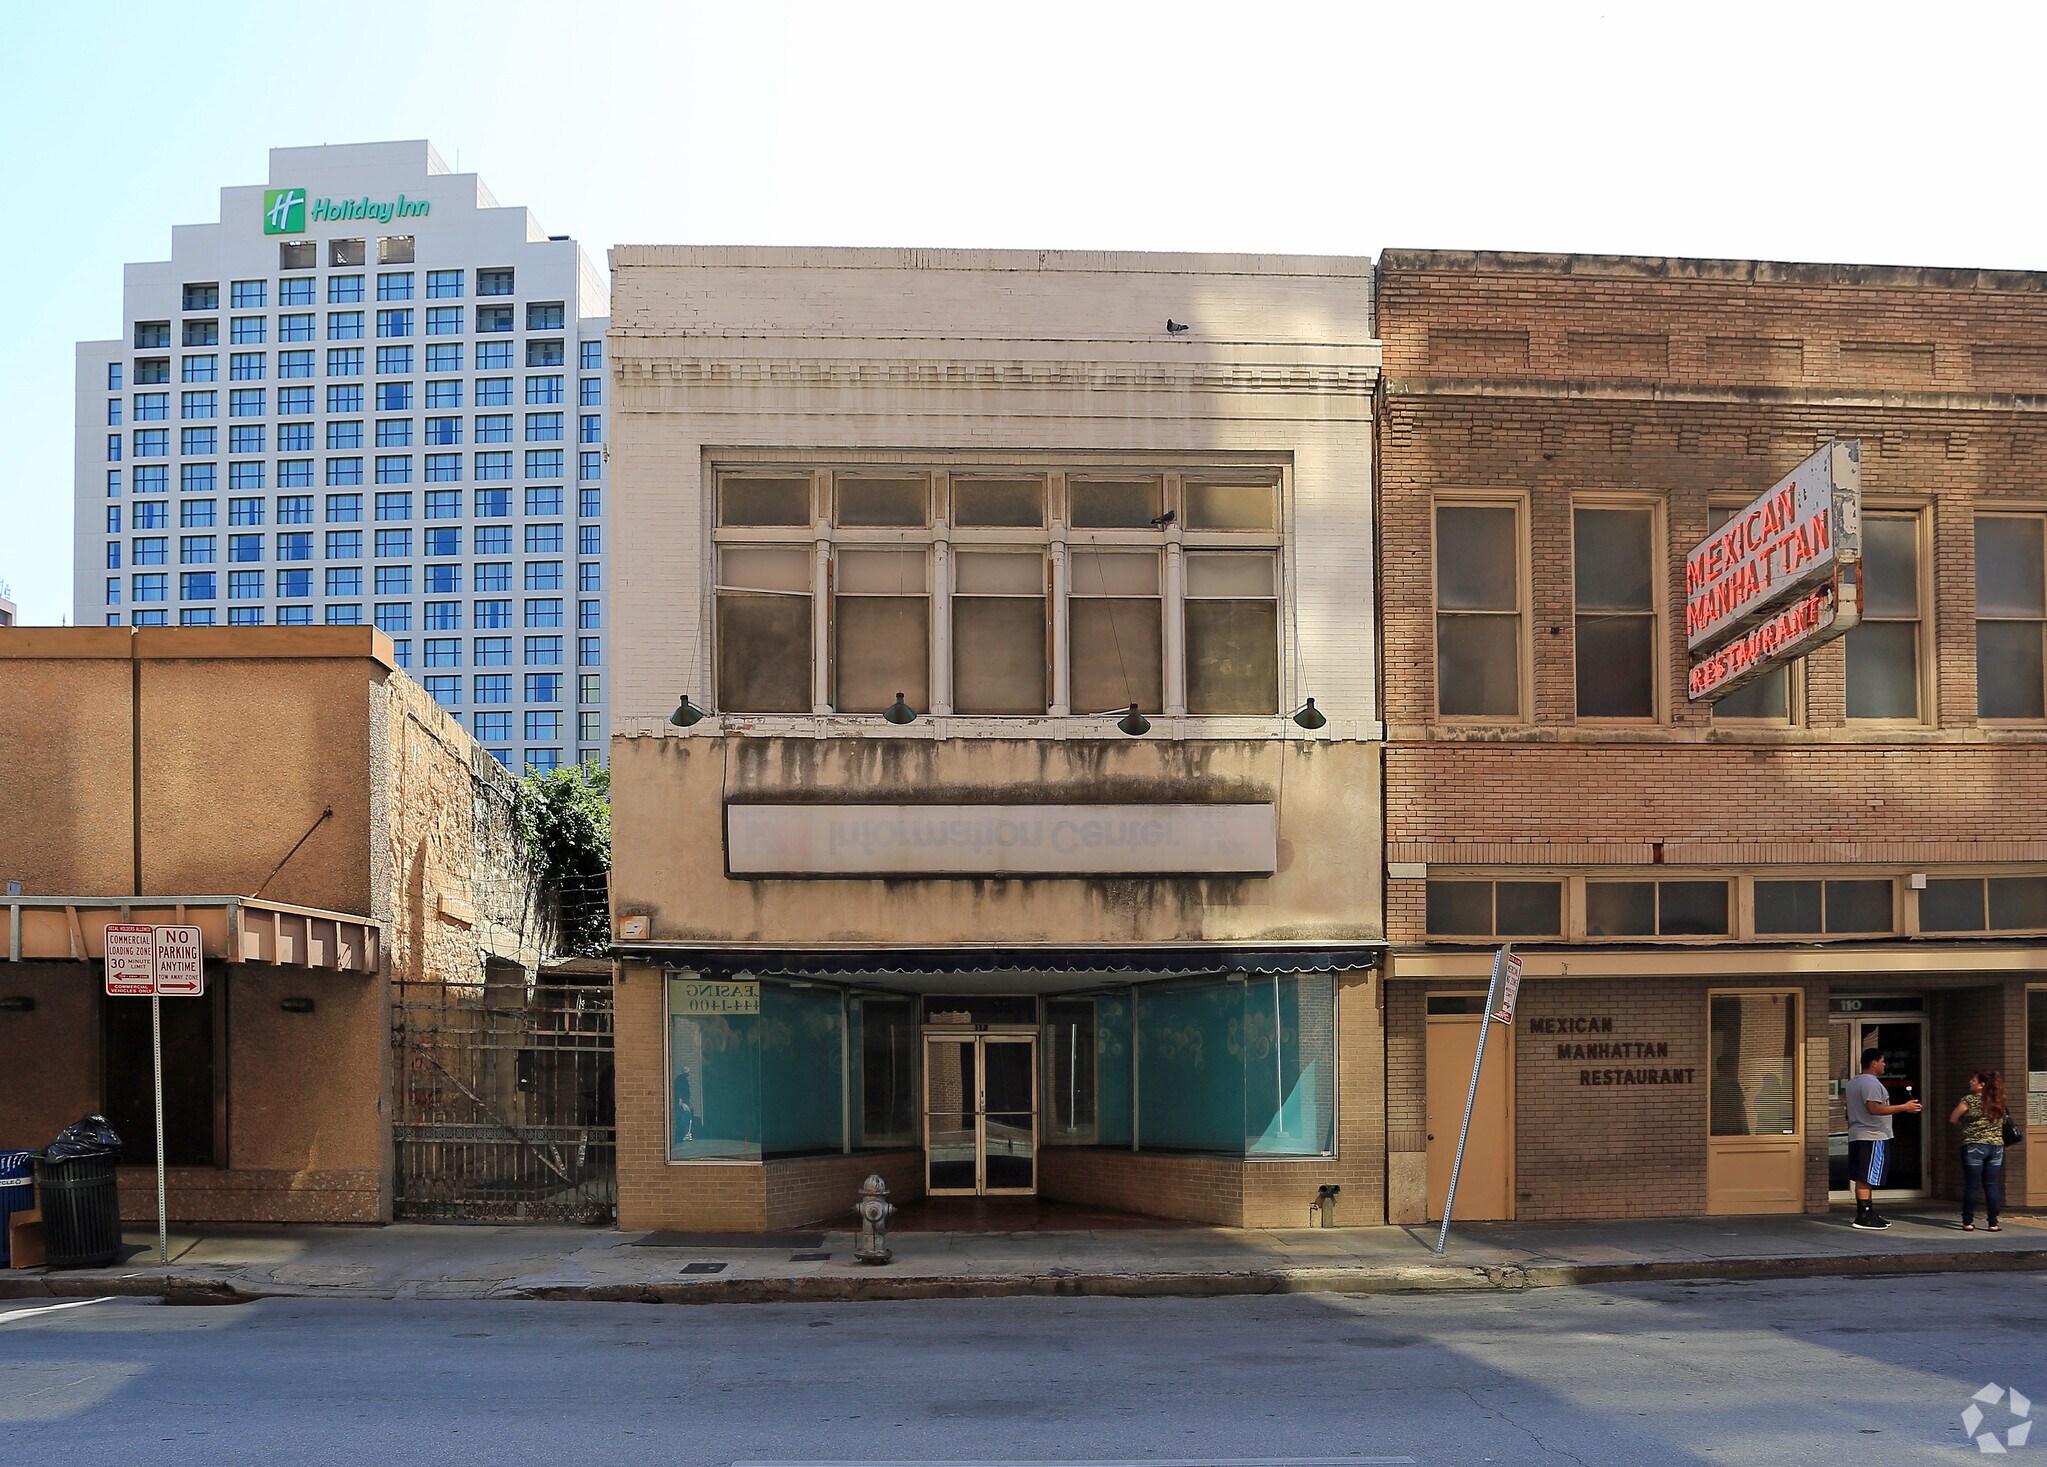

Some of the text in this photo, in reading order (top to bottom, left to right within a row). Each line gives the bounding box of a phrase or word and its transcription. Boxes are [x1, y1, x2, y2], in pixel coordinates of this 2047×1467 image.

[312, 194, 430, 223] Holiday Inn
[1686, 482, 1796, 596] MEXICAN
[1686, 508, 1830, 637] MANHATTAN
[1690, 596, 1820, 693] RESTAURANT
[110, 935, 150, 945] COMMERCIAL
[166, 930, 188, 943] NO
[109, 946, 151, 956] LOADING ZONE
[158, 946, 197, 959] PARKING
[111, 958, 125, 968] 30
[160, 961, 196, 972] ANYTIME
[1840, 999, 1862, 1011] 110
[1530, 1017, 1612, 1033] MEXICAN
[1558, 1042, 1667, 1059] MANHATTAN
[1580, 1068, 1695, 1086] RESTAURANT
